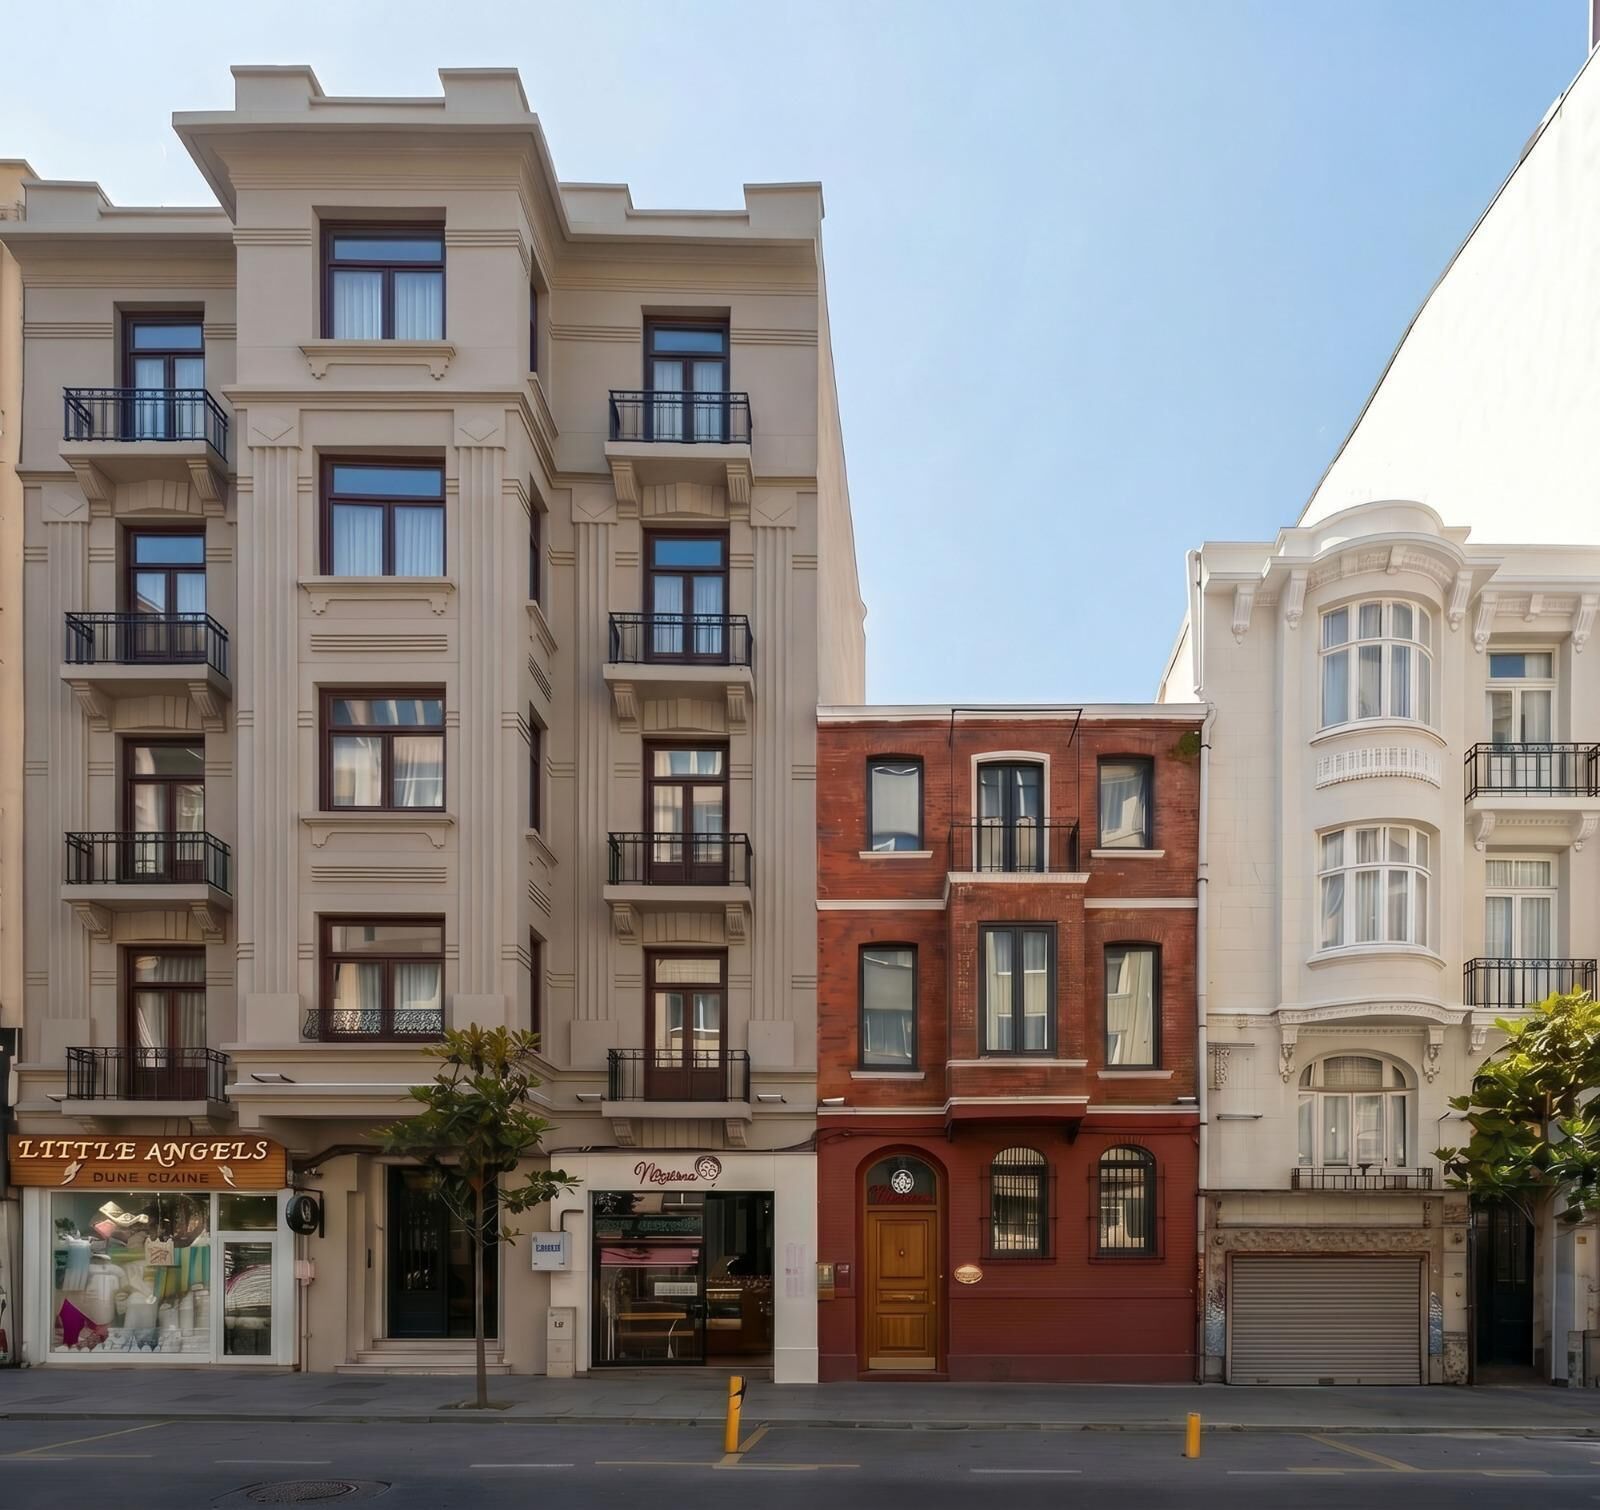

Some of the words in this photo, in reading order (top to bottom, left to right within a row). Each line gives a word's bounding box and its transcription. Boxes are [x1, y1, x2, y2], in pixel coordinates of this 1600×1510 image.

[18, 1140, 136, 1161] LITTLE
[144, 1141, 268, 1168] ANGELS
[93, 1172, 139, 1183] DUNE
